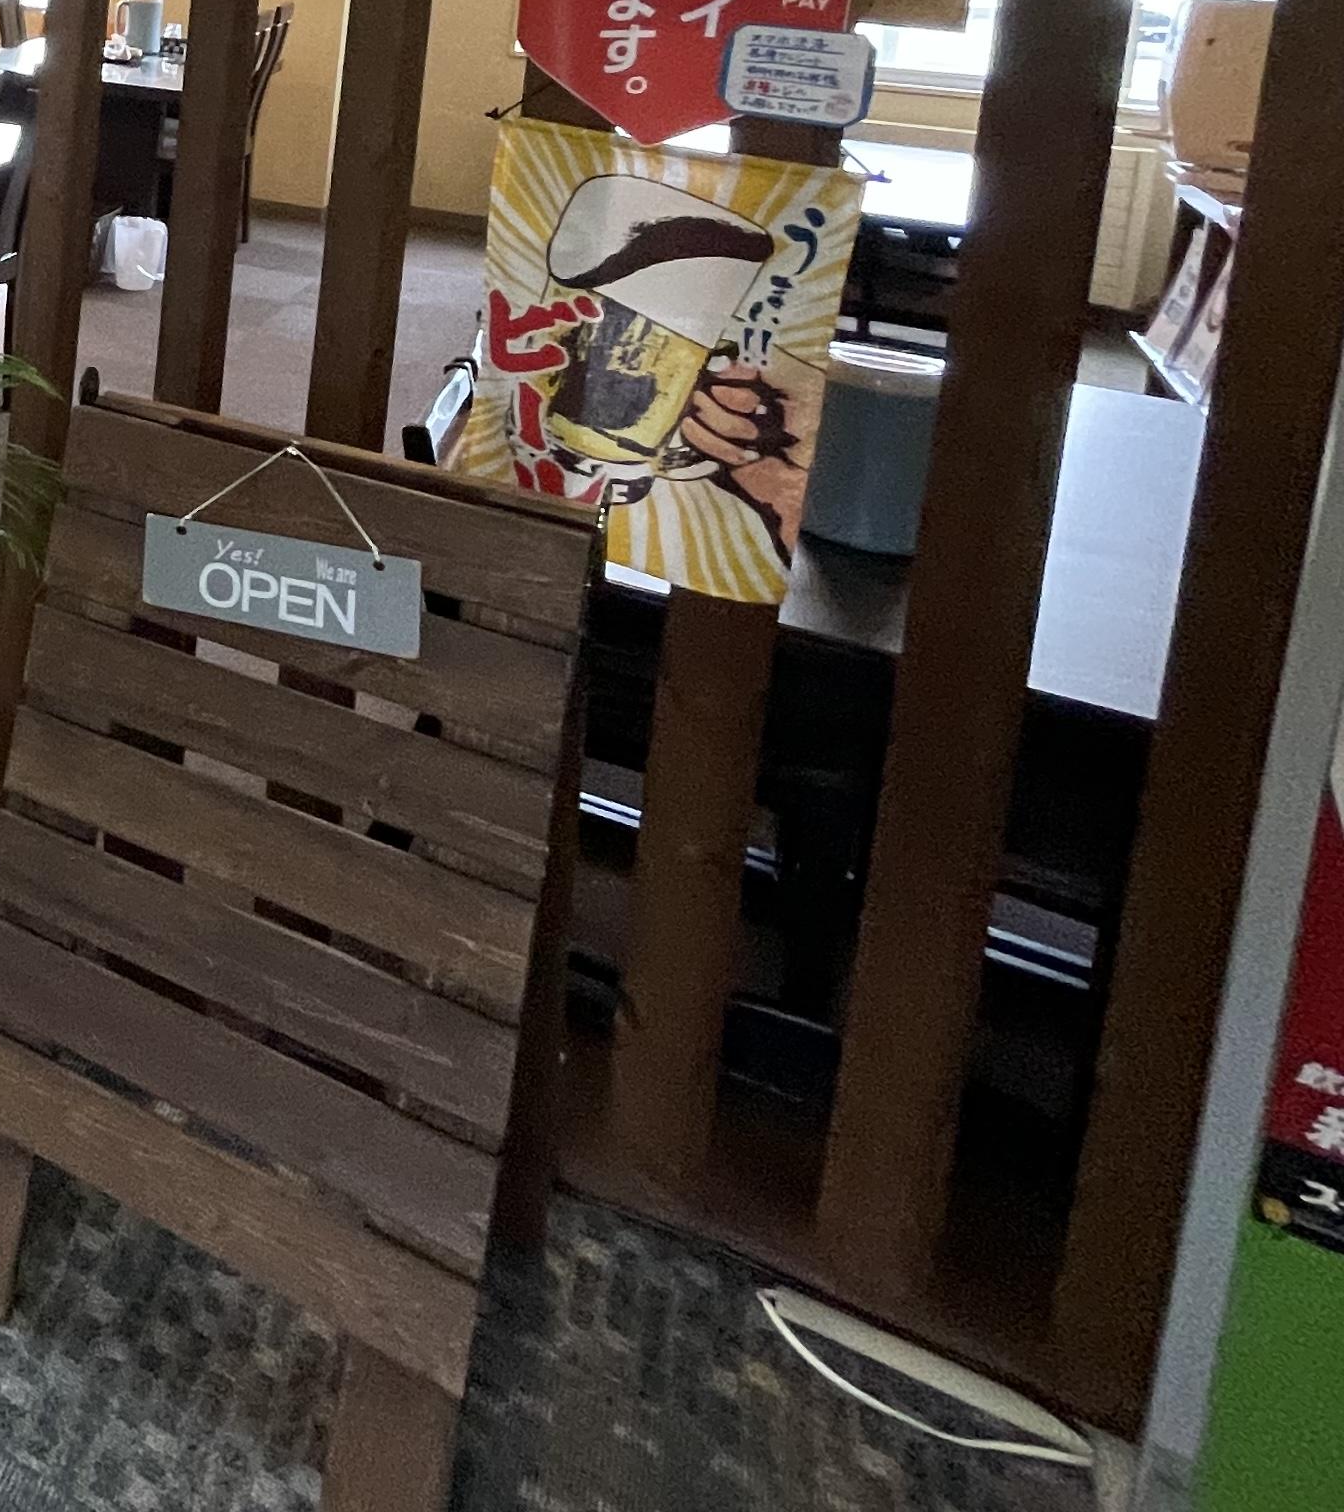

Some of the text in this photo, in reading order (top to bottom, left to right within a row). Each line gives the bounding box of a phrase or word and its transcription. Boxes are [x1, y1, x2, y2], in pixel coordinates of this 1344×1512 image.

[213, 538, 265, 566] Yes!
[315, 556, 357, 586] We are
[198, 561, 356, 636] OPEN
